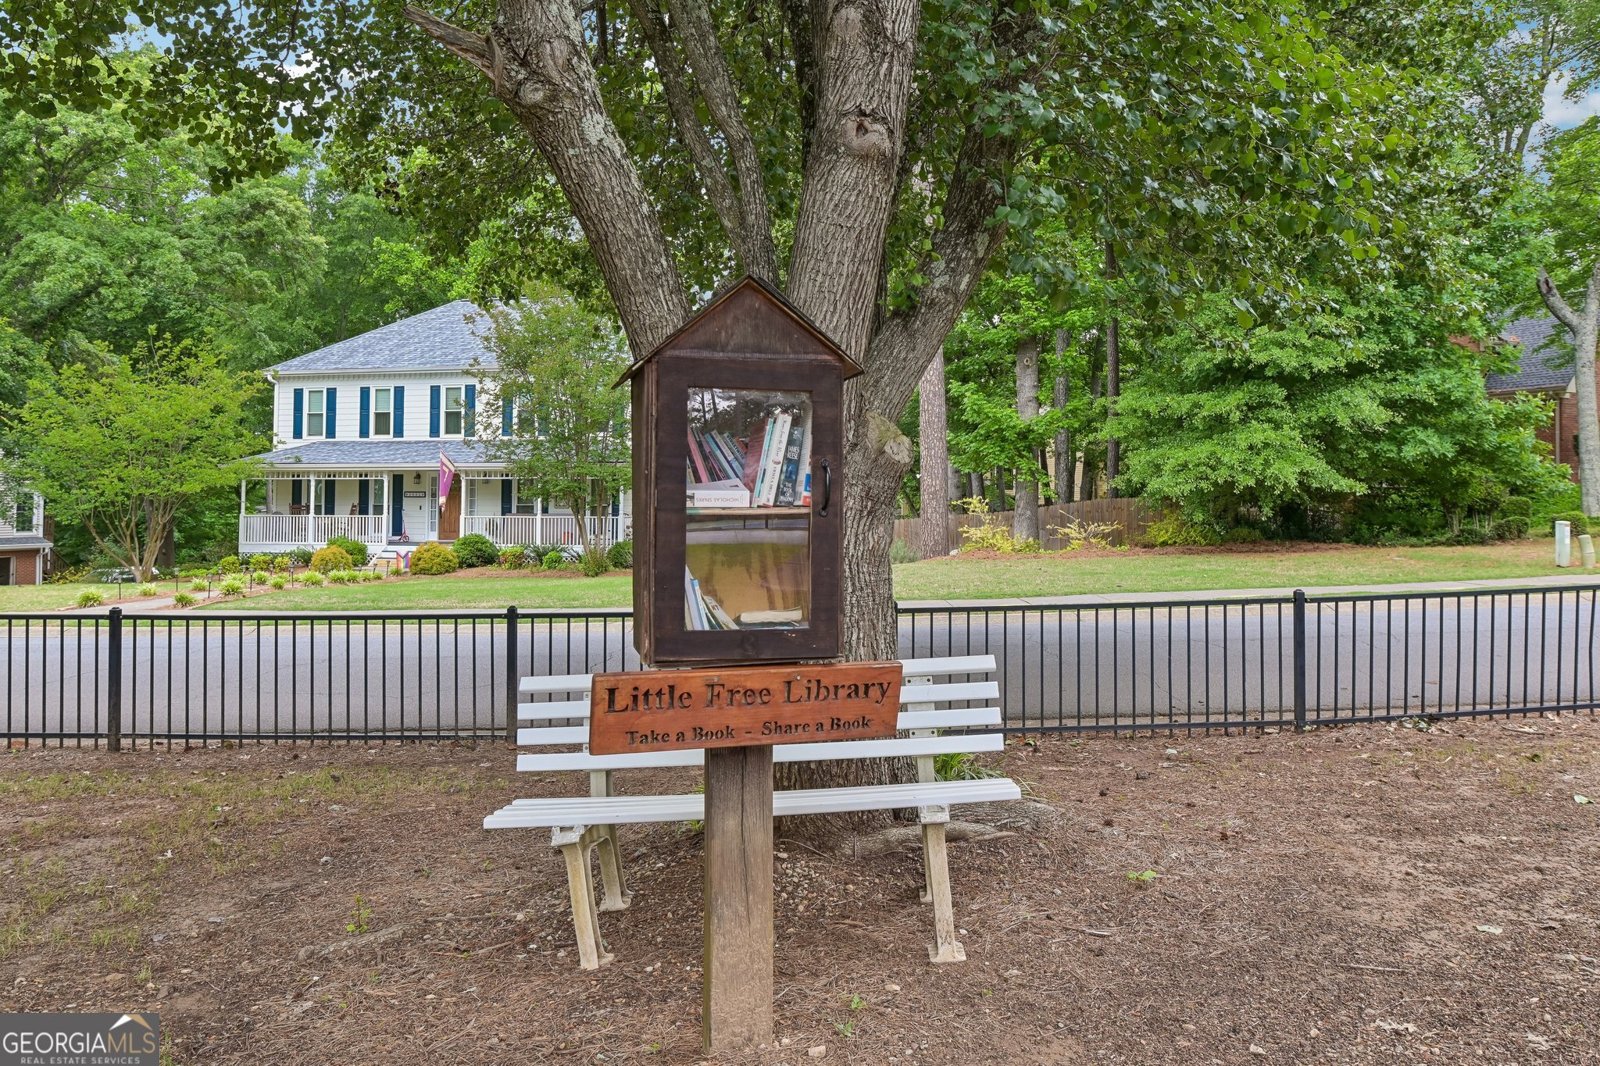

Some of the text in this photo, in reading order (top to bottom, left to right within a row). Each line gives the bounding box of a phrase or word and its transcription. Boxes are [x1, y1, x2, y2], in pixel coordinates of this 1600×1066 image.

[604, 678, 892, 714] Little Free Library
[625, 729, 670, 746] Take
[675, 731, 685, 742] a
[691, 725, 736, 742] Book
[761, 719, 810, 736] Share
[815, 721, 825, 733] a
[830, 715, 872, 732] Book
